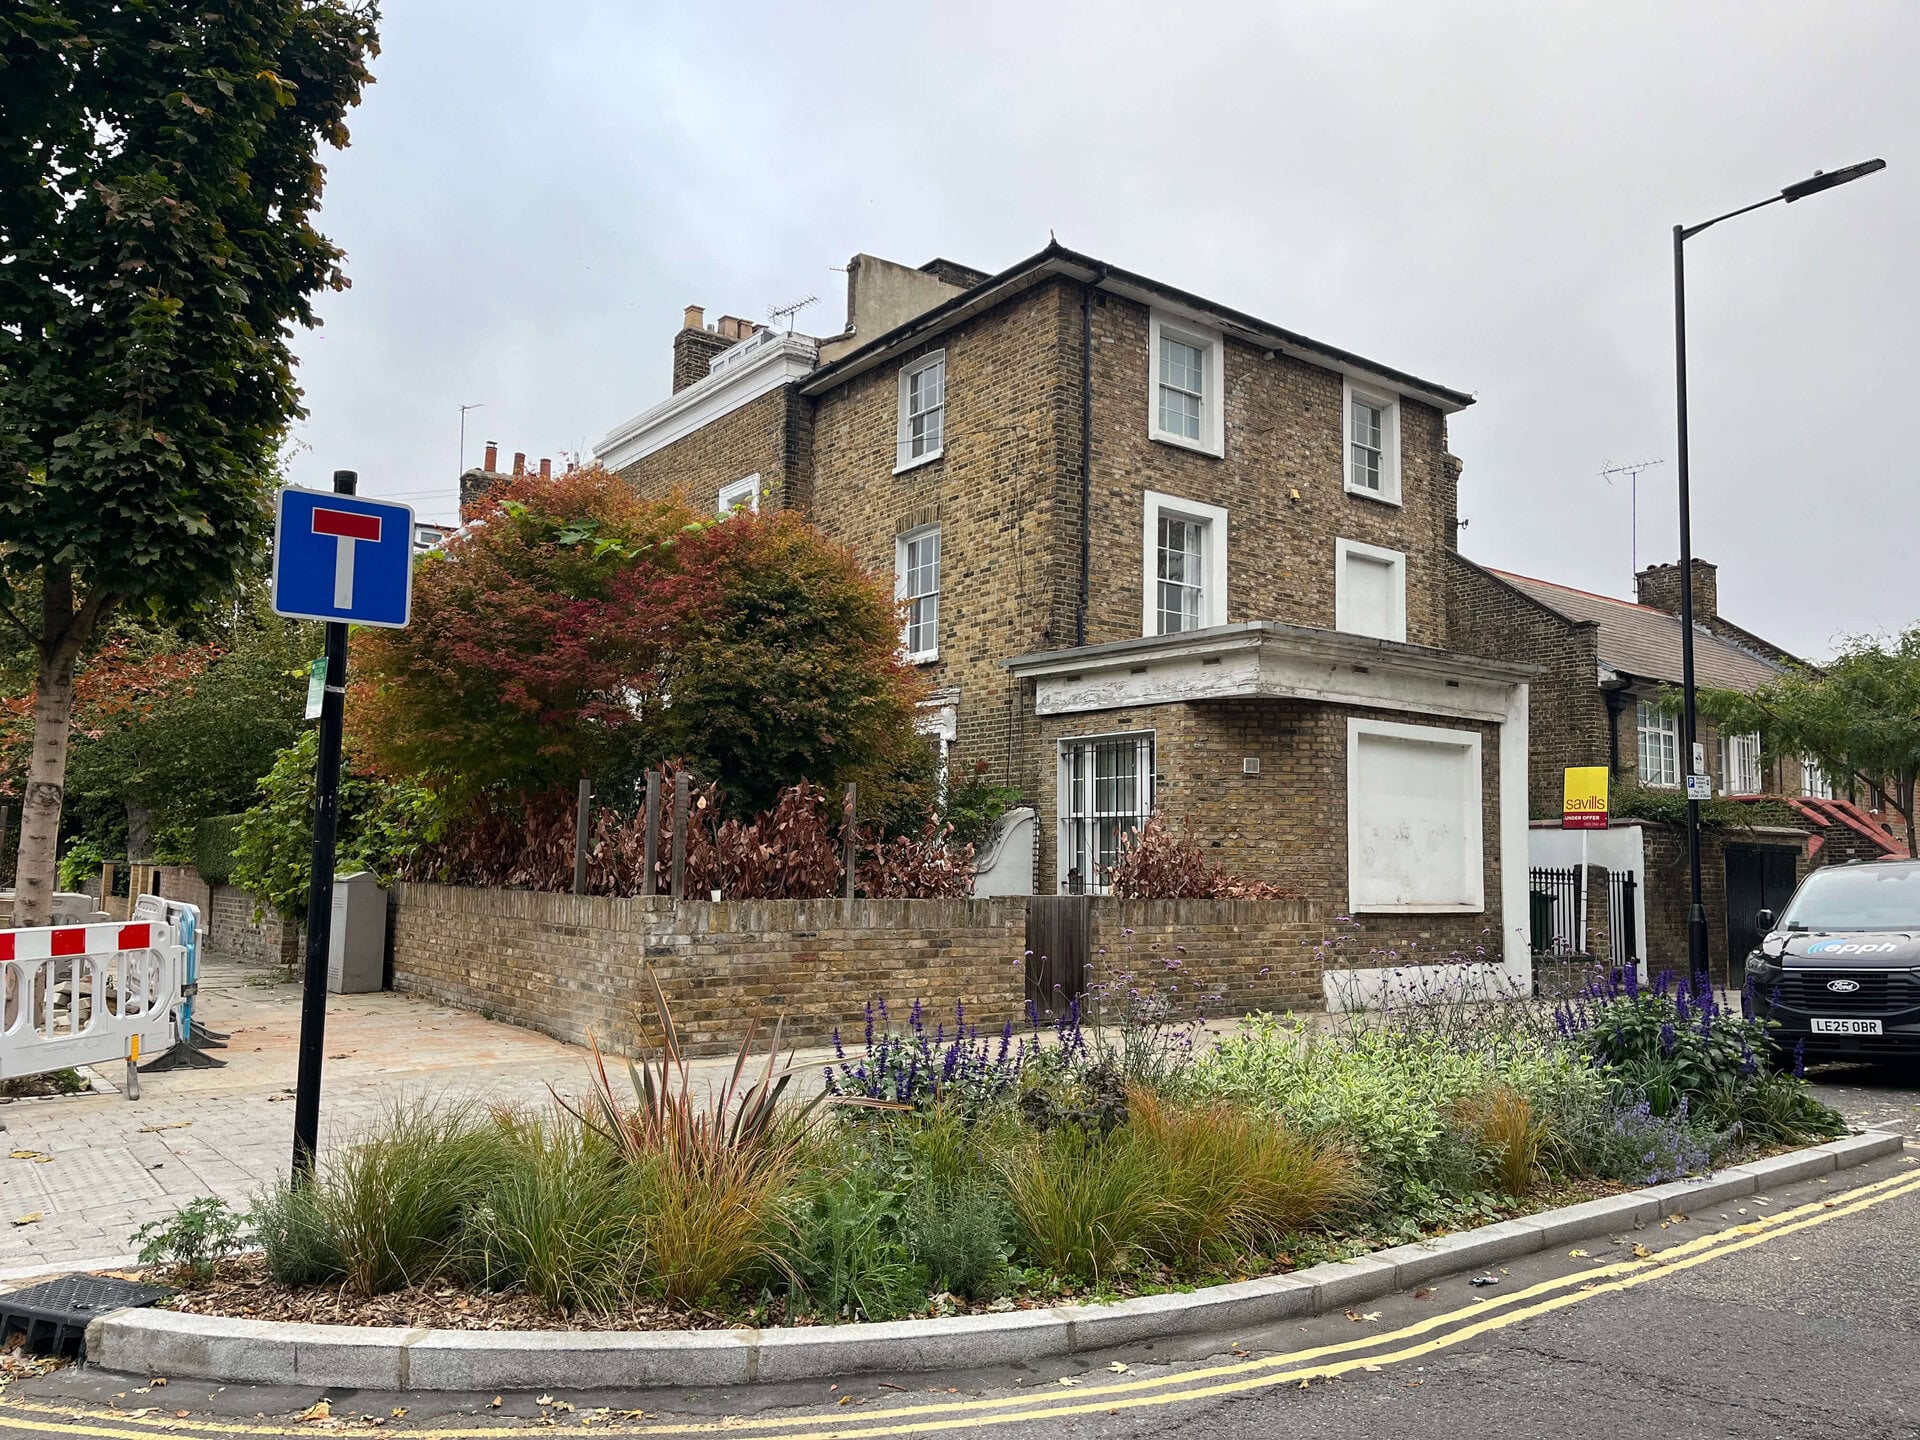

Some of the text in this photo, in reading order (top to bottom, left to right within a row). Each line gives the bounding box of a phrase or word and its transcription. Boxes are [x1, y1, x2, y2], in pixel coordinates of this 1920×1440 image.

[1566, 795, 1605, 810] savills
[1832, 981, 1854, 991] Ford
[1816, 1021, 1877, 1033] LE25 OBR
